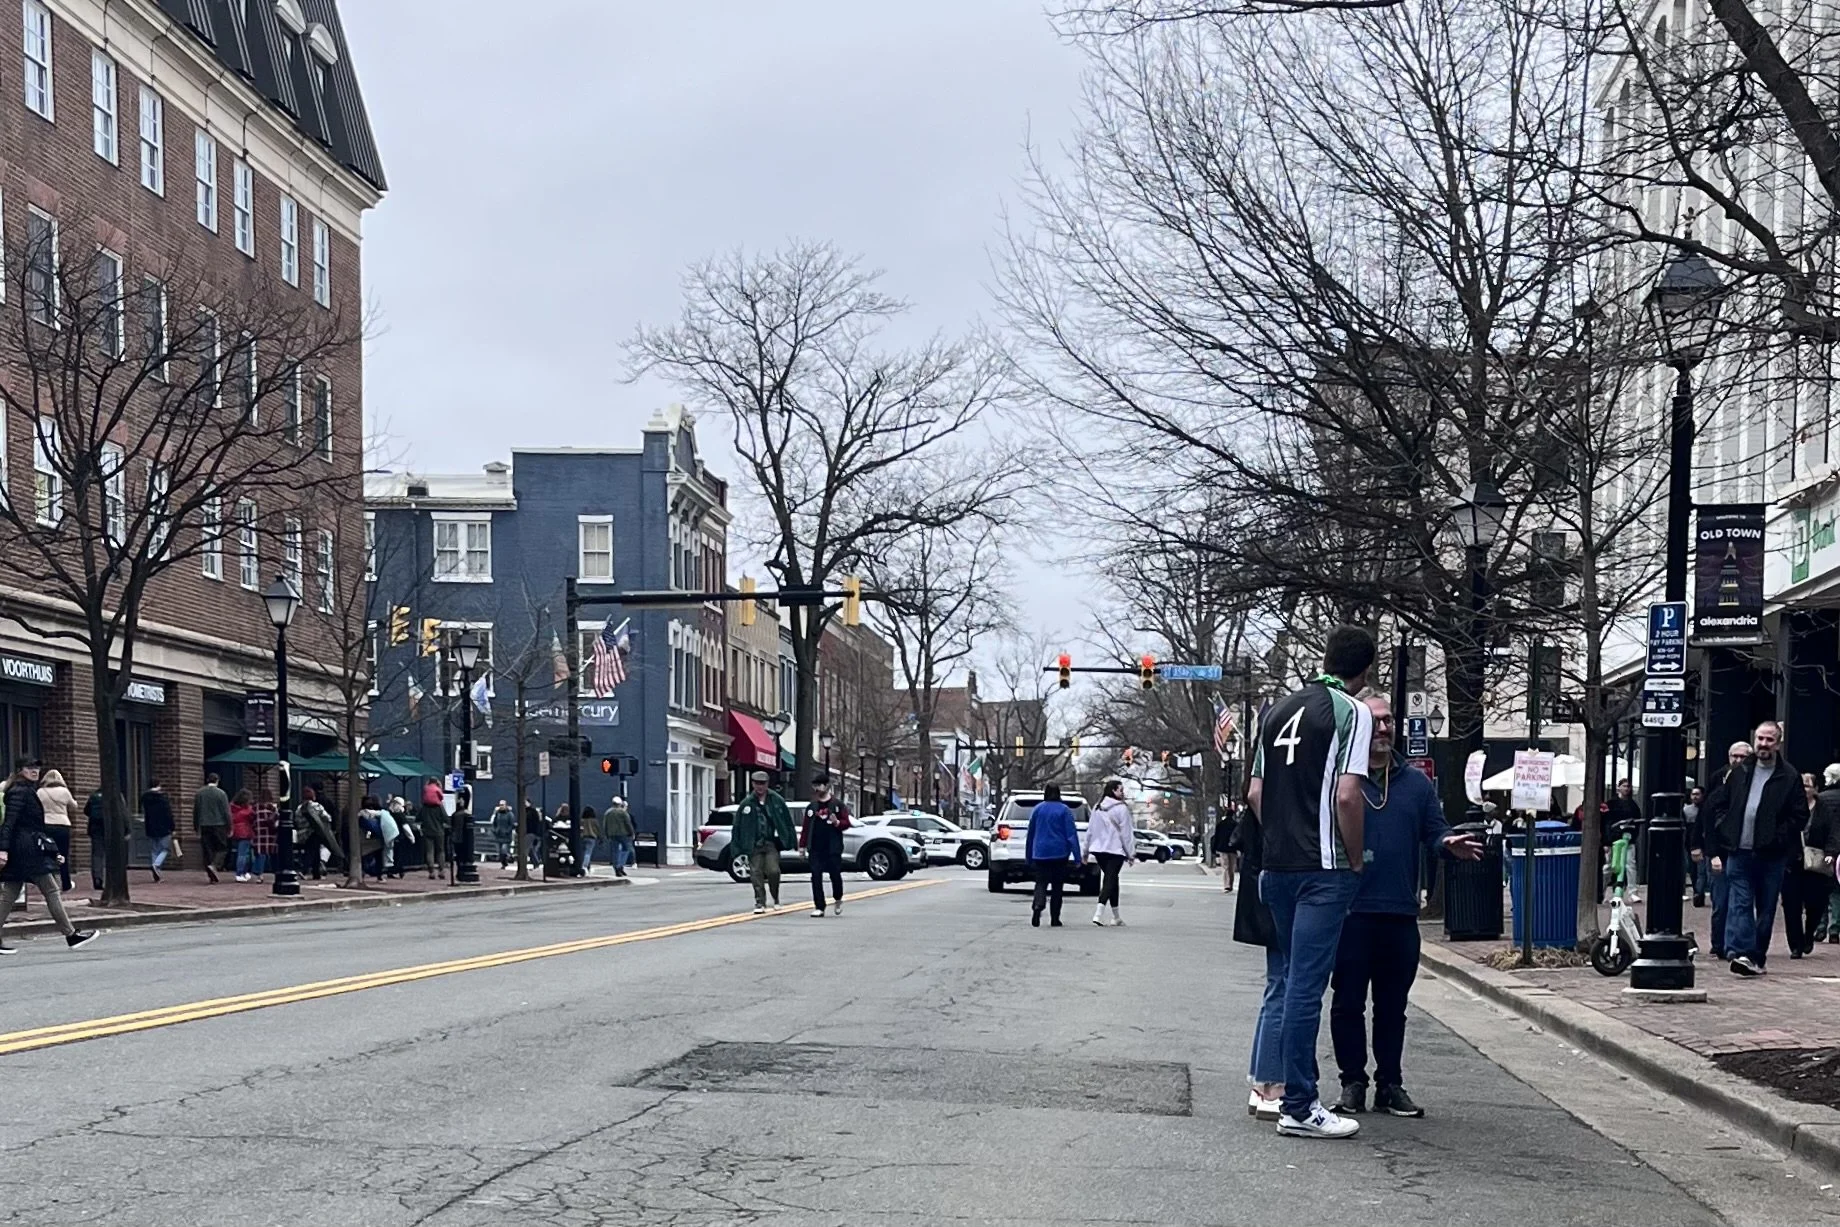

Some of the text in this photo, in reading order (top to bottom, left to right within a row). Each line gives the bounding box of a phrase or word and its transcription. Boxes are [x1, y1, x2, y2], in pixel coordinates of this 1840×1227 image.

[1700, 528, 1762, 540] OLD TOWN
[1661, 607, 1675, 628] P
[1700, 614, 1758, 626] alexandria
[2, 658, 53, 683] VOORTHUIS
[1273, 706, 1305, 766] 4
